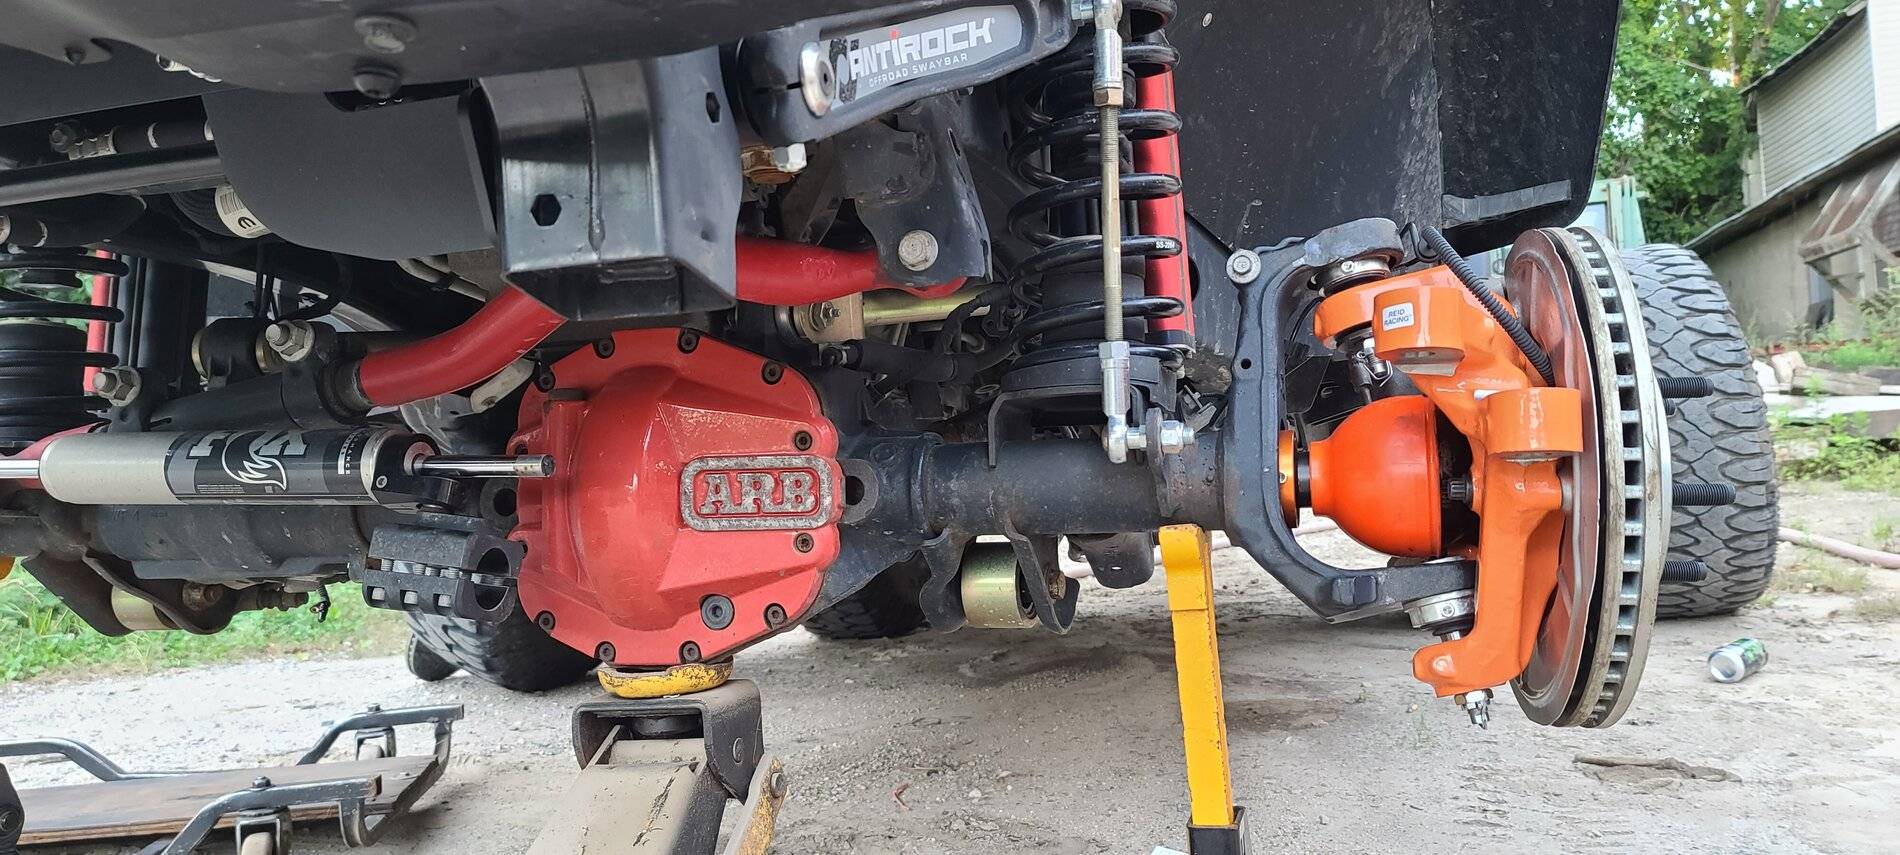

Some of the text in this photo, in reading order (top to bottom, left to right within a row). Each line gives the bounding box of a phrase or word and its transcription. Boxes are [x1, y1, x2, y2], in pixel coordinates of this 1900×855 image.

[868, 53, 969, 89] OFFROAD SWAYBAR
[699, 471, 817, 515] ARB
